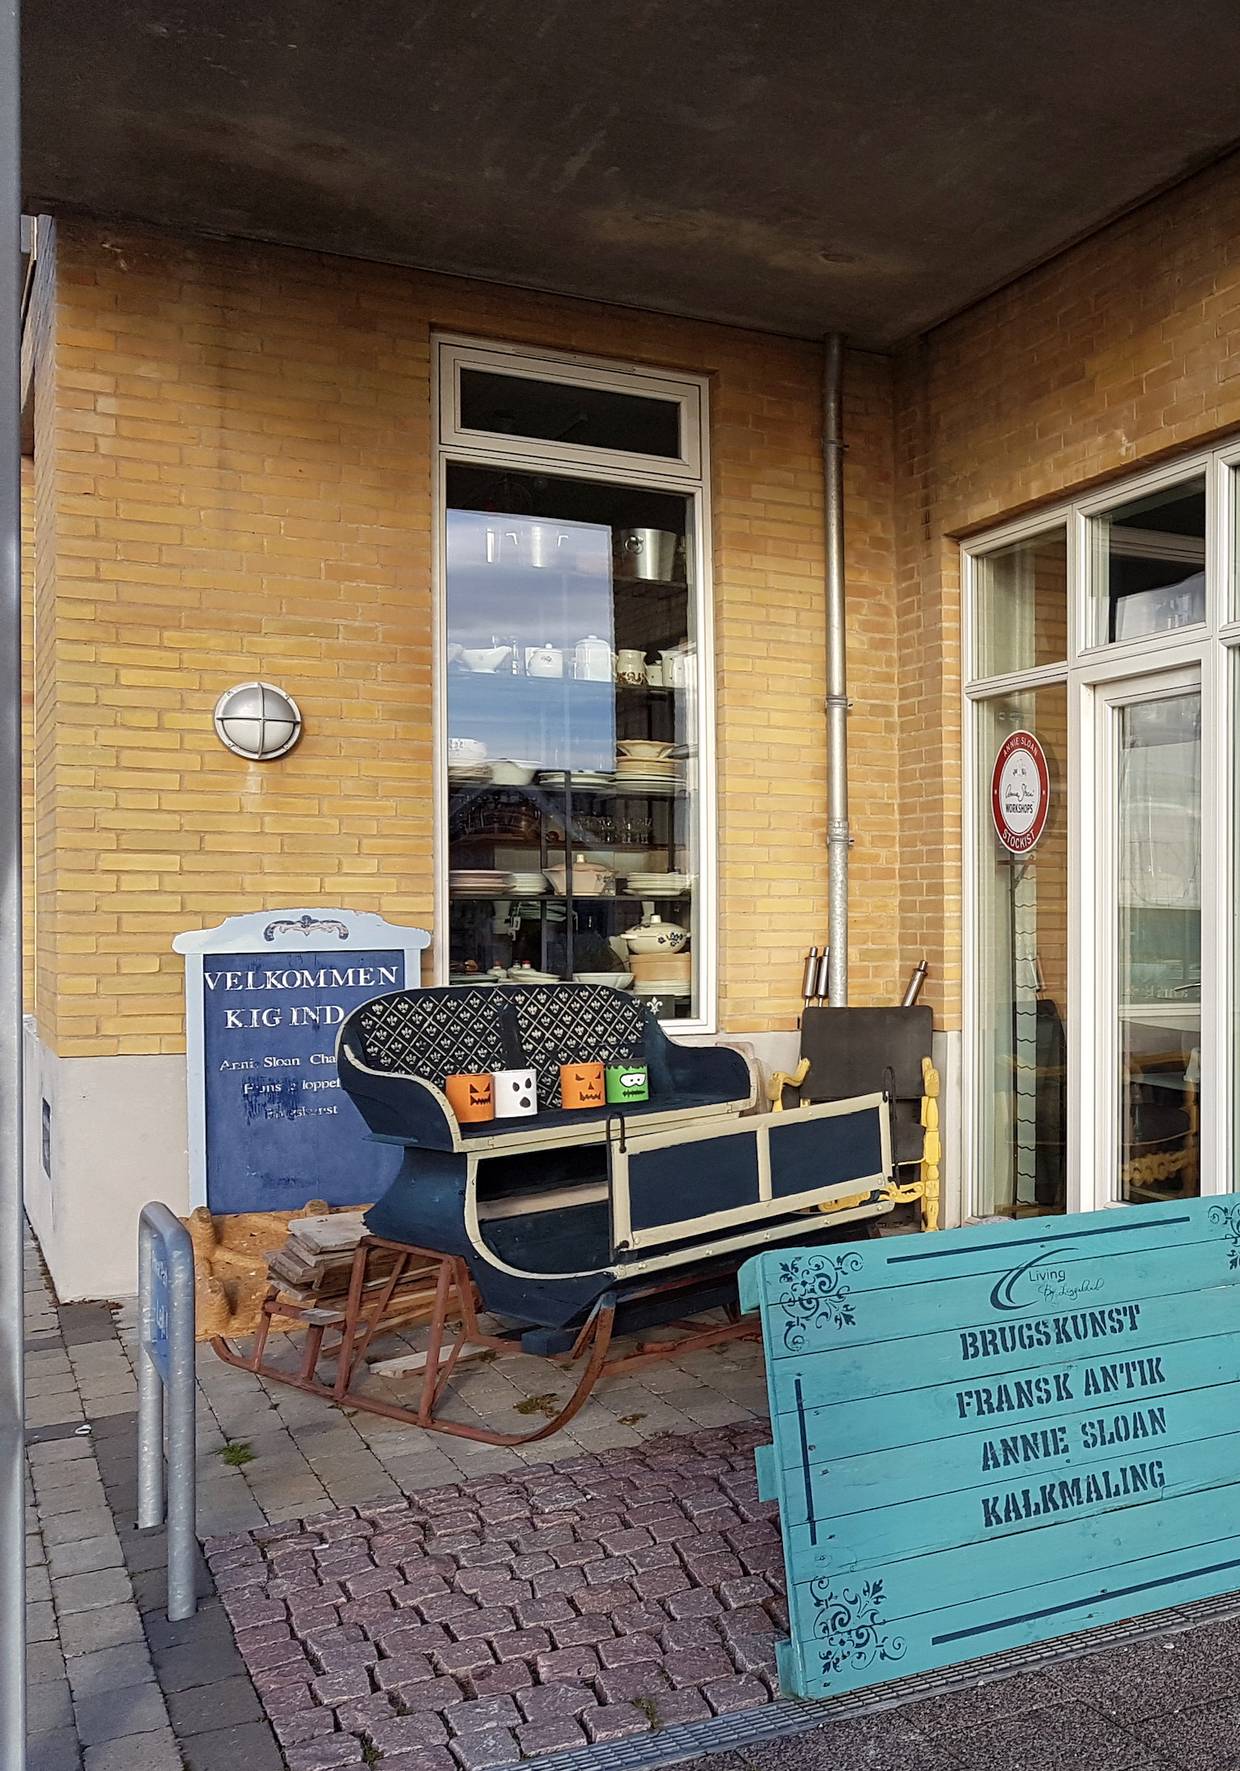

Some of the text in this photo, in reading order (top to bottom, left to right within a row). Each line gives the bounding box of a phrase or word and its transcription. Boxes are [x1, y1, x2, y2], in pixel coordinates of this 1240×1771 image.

[1003, 736, 1038, 757] ANNIE SLOAN
[1005, 803, 1034, 814] WORKSHOPS
[1002, 829, 1035, 849] STOCKIST
[205, 966, 399, 991] VELKOMMEN
[224, 1005, 345, 1029] KIG IND
[219, 1054, 336, 1072] Anni Sloan Cha
[1029, 1269, 1066, 1283] Living
[960, 1304, 1140, 1360] BRUGSKUNST
[956, 1357, 1166, 1418] FRANSK ANTIK
[982, 1407, 1167, 1471] ANNIE SLOAN
[982, 1460, 1165, 1528] KALKMALING
